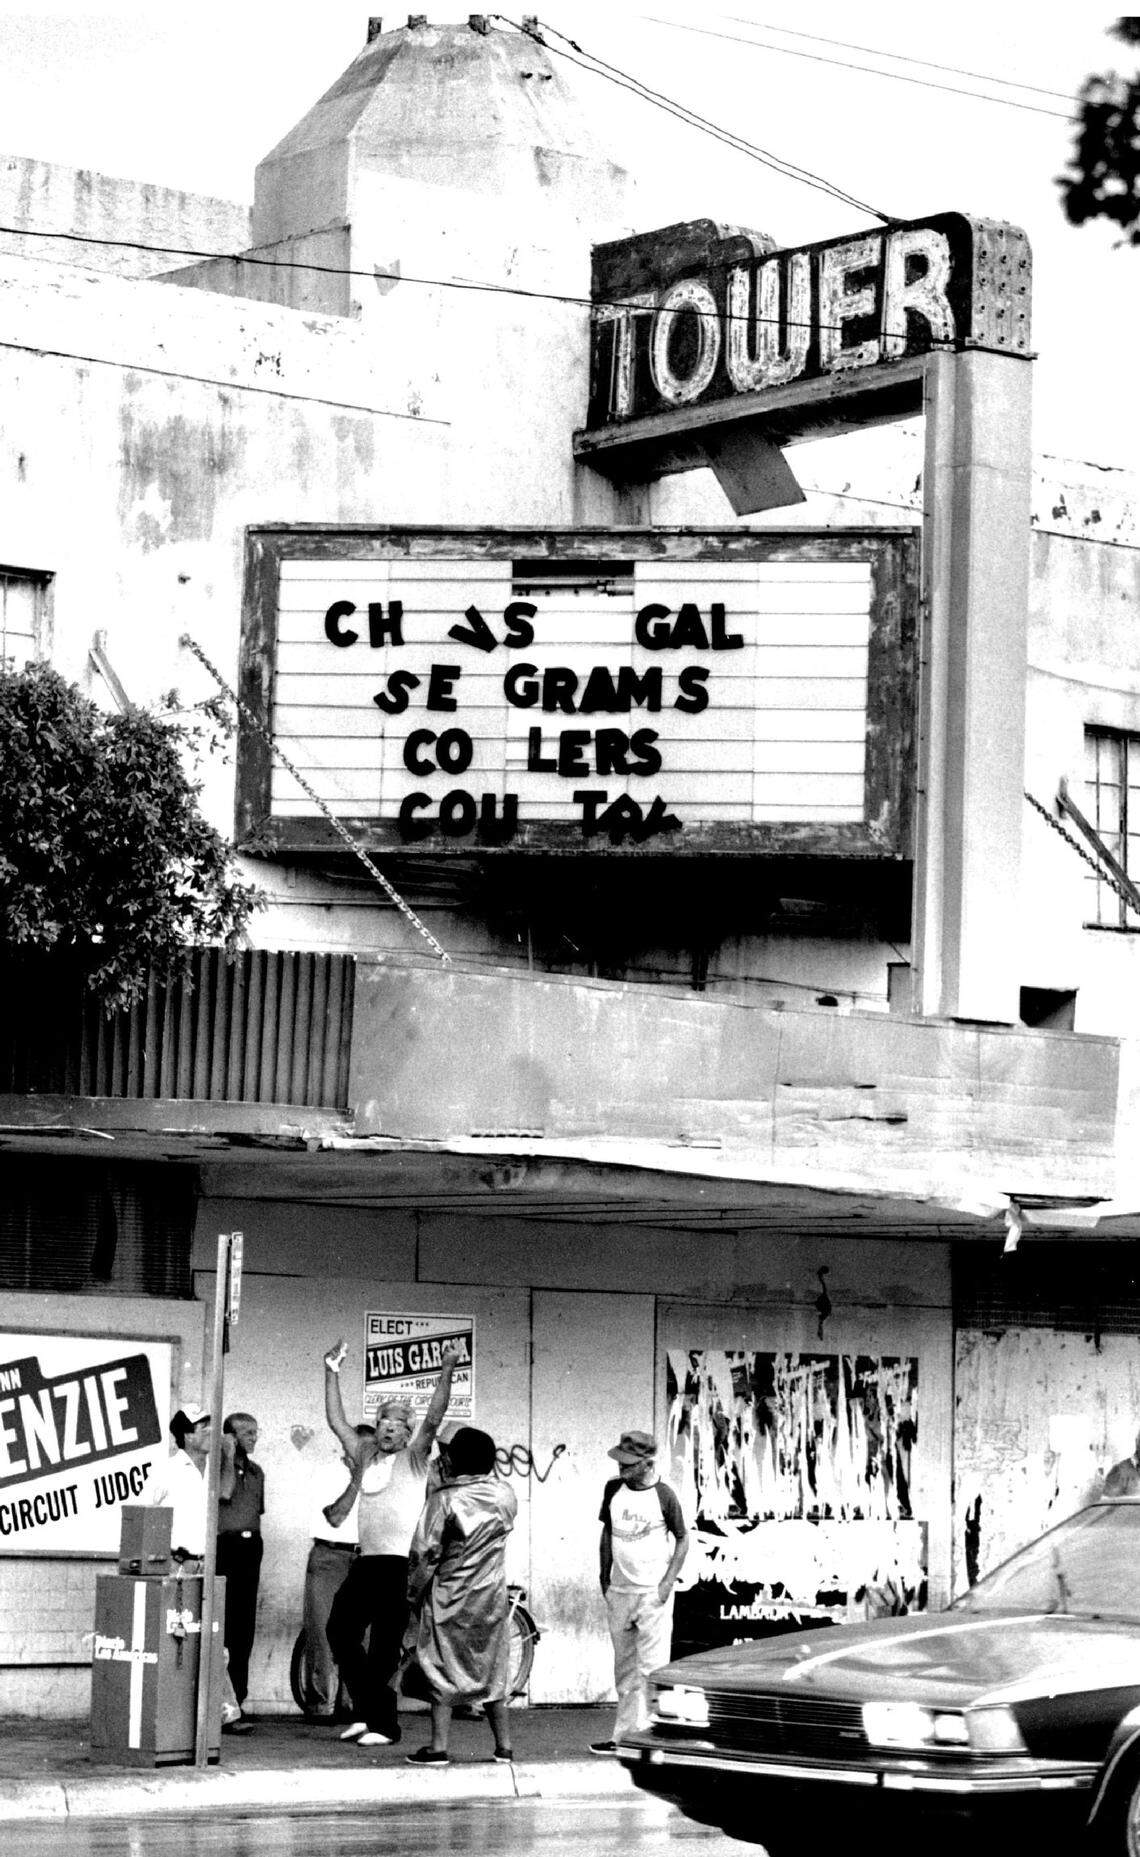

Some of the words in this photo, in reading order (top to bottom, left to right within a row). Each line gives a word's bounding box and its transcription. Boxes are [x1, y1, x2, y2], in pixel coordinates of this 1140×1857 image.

[591, 228, 956, 420] TOWER
[325, 601, 405, 648] CH
[636, 604, 744, 650] GAL
[374, 665, 460, 714] SE
[504, 663, 709, 714] GRAMS
[404, 728, 473, 776] CO
[527, 727, 661, 777] LERS
[400, 789, 519, 846] COU
[368, 1347, 404, 1377] LUIS
[0, 1484, 78, 1536] CIRCUIT
